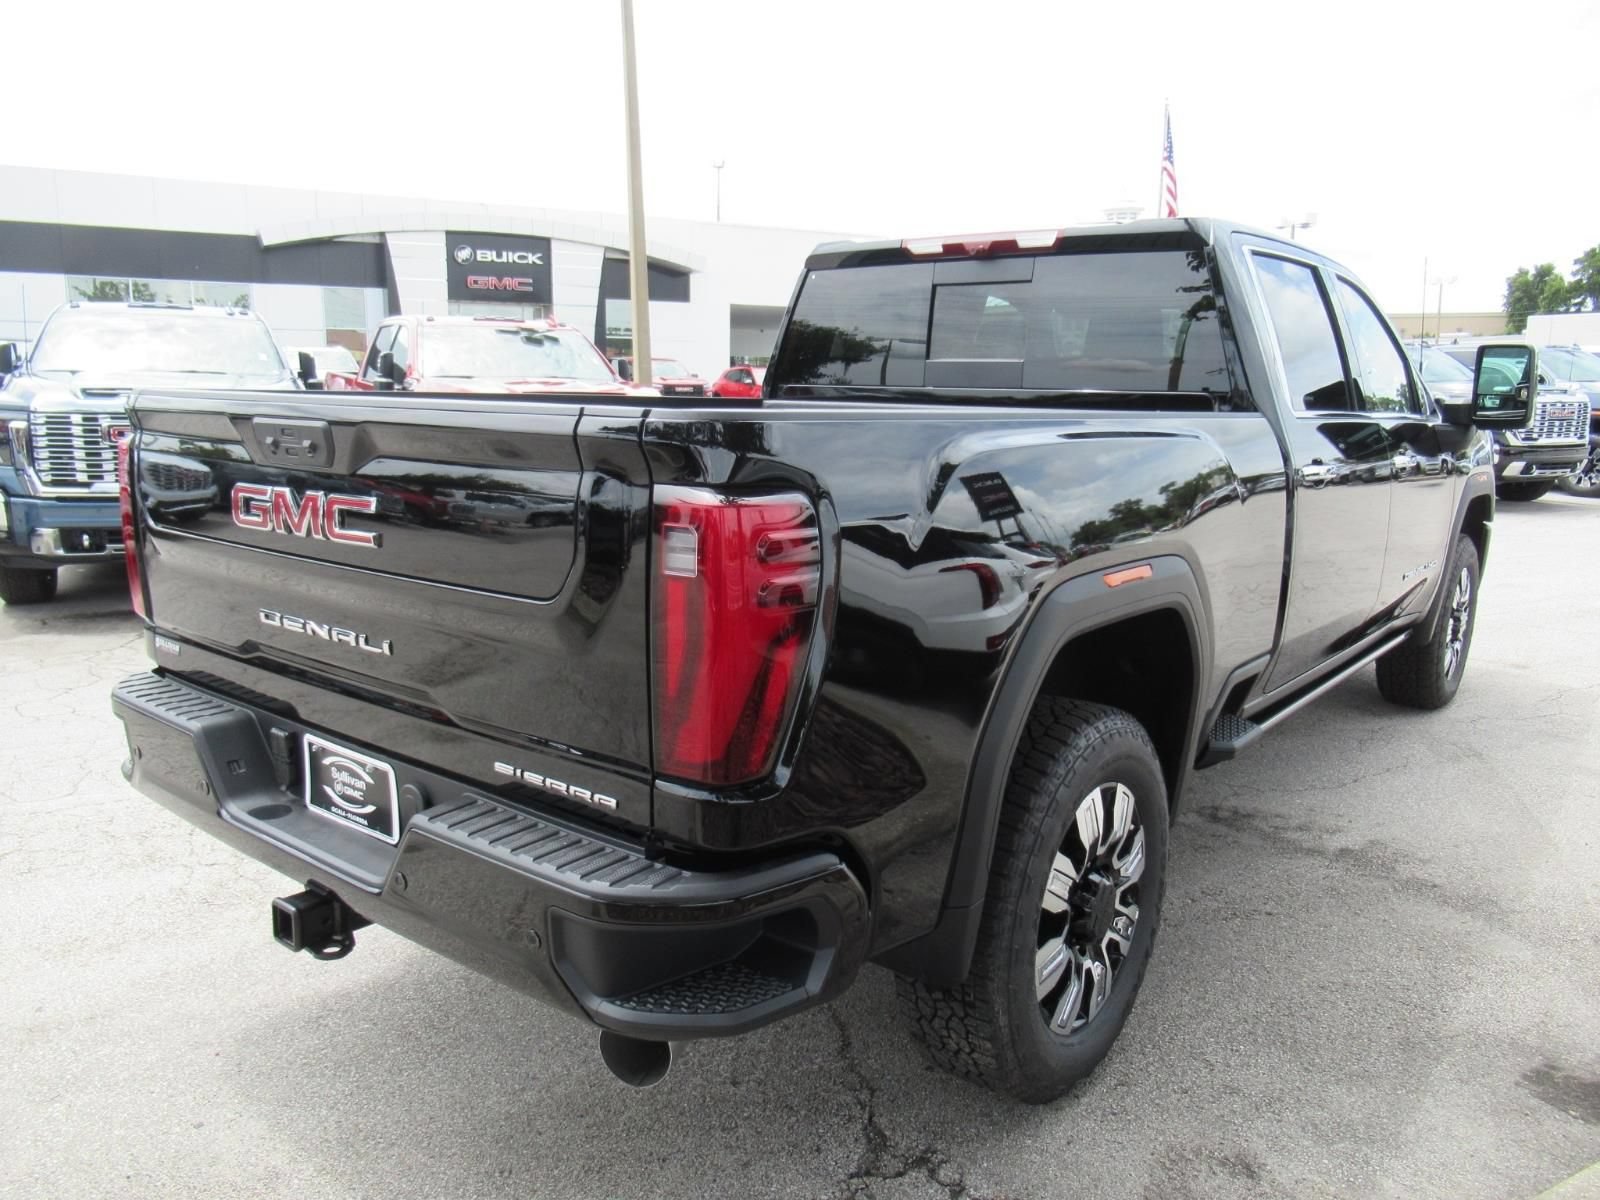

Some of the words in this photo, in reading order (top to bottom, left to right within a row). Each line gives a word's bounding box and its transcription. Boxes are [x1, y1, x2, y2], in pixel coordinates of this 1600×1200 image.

[476, 249, 543, 264] BUICK
[467, 275, 533, 291] GMC
[231, 482, 380, 548] GMC
[258, 608, 393, 656] DENALI
[331, 767, 366, 791] Sullivan
[493, 761, 619, 811] SIERRA
[343, 785, 364, 801] GMC
